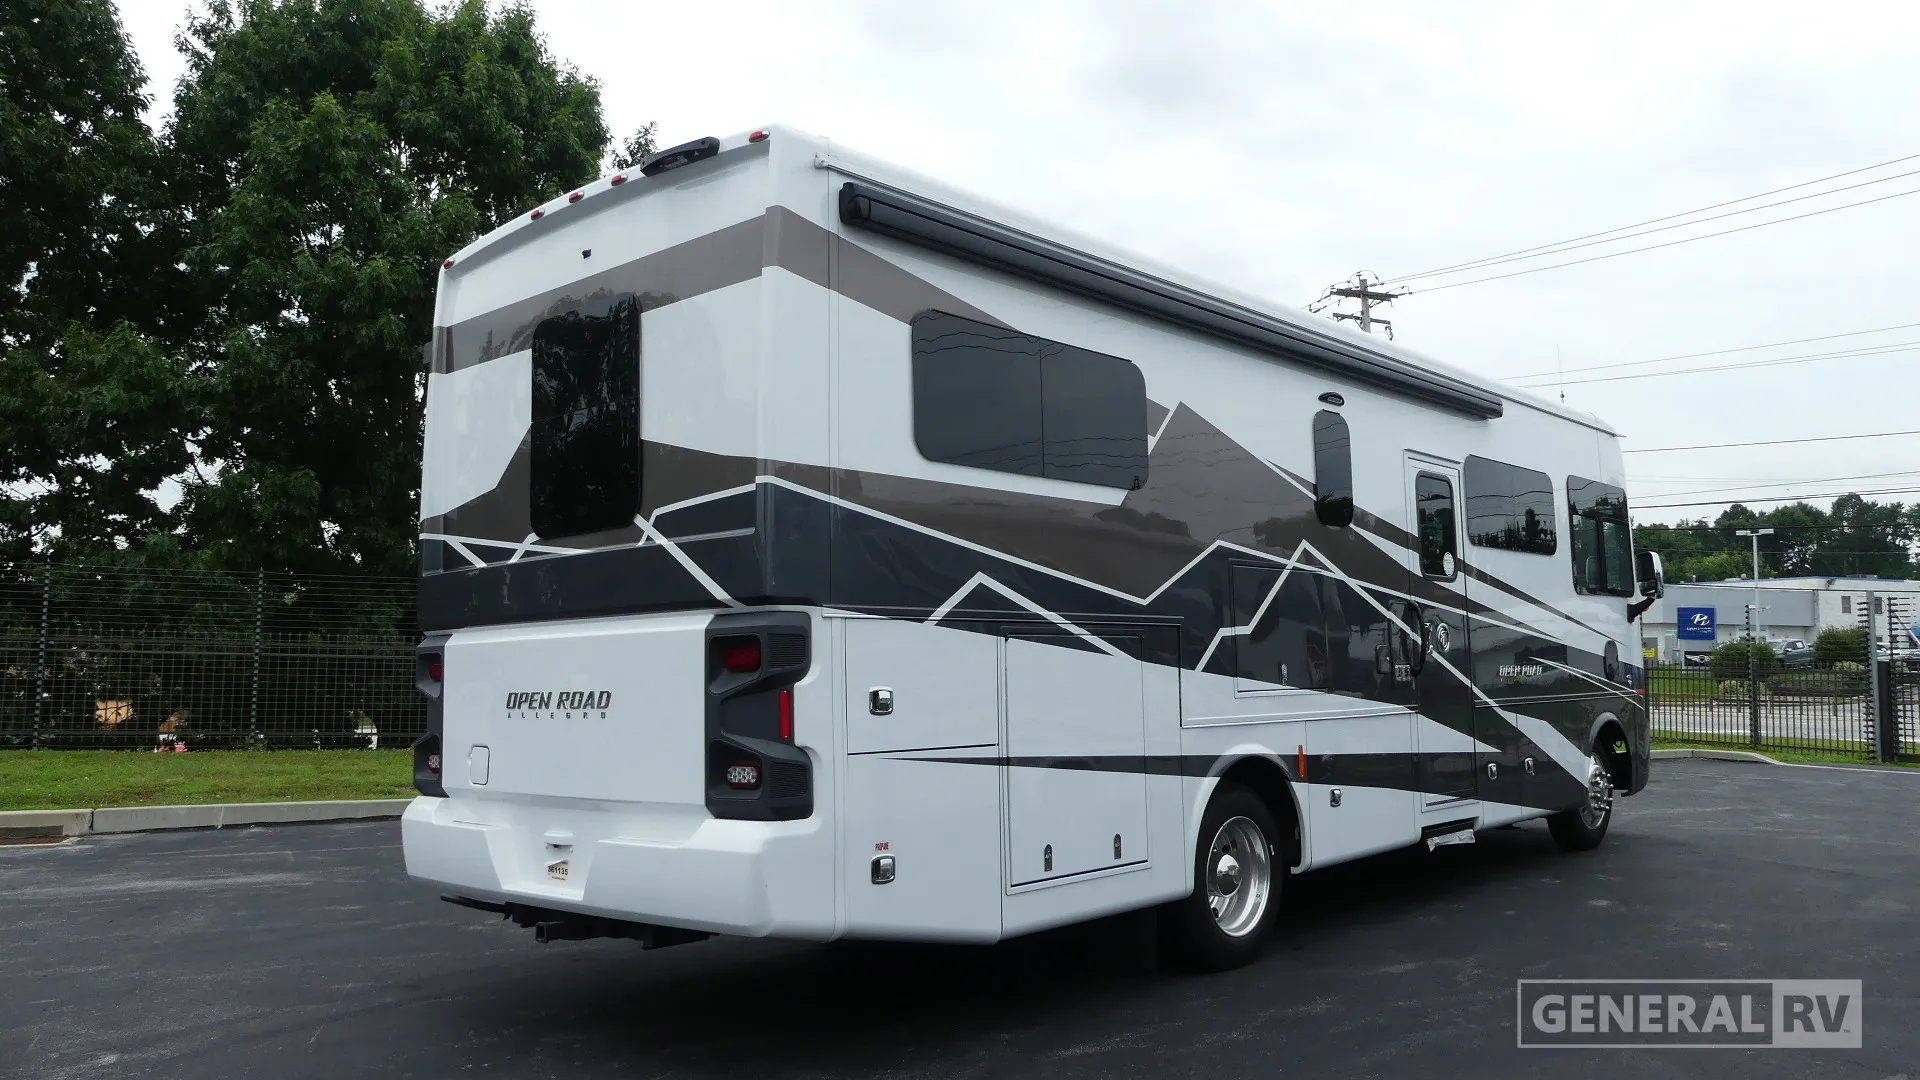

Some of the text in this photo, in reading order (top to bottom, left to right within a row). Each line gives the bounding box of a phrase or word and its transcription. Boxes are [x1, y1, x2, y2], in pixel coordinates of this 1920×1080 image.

[506, 690, 612, 709] OPEN ROAD
[507, 711, 606, 720] ALLEGRO
